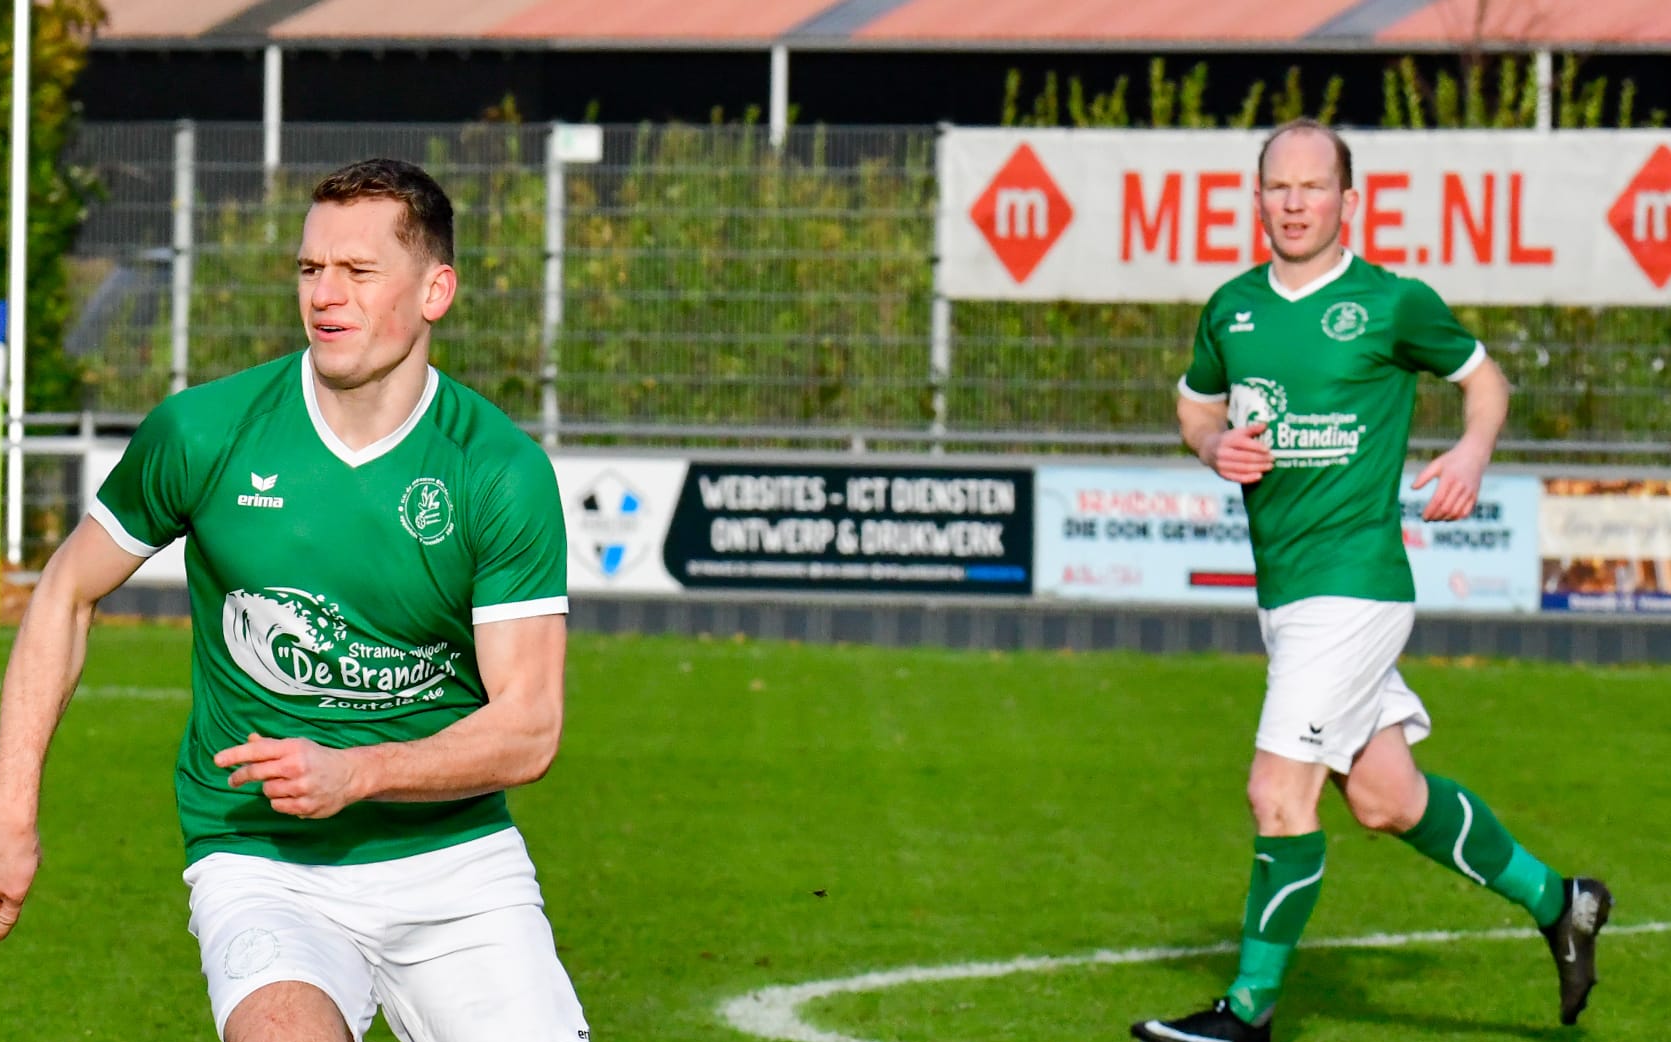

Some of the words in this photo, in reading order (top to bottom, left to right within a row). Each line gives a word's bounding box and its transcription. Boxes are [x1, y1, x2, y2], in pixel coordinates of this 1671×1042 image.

[1119, 171, 1555, 265] MEE.NL
[237, 493, 284, 508] erima
[698, 475, 826, 511] WEBSITES
[846, 477, 888, 513] ICT
[891, 478, 1015, 514] DIENSTEN
[710, 516, 835, 553] ONTWERP
[836, 518, 858, 555] &
[860, 520, 1005, 556] DRUKWERK
[1063, 518, 1097, 539] DIE
[1105, 519, 1149, 540] OOK
[1432, 528, 1512, 551] HOUDT
[277, 645, 333, 685] "De
